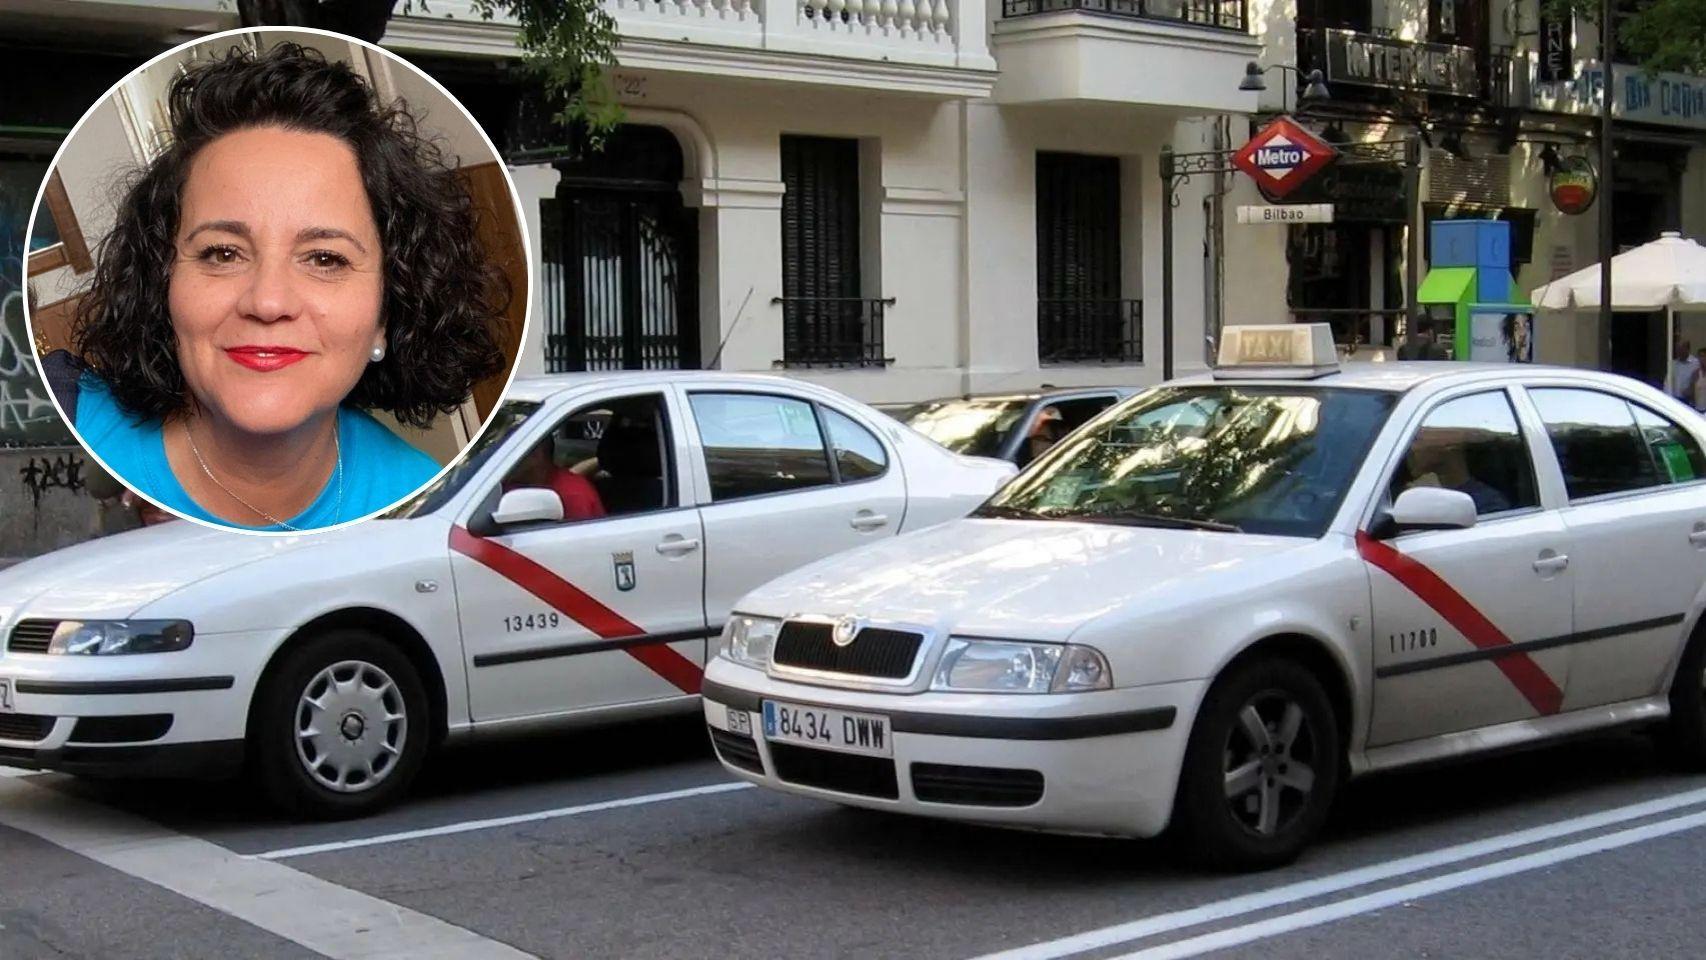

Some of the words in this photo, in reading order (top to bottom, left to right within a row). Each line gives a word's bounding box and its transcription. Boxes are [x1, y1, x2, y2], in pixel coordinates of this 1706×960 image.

[1257, 148, 1301, 166] Metro
[1263, 208, 1304, 221] Bilbao
[1242, 334, 1291, 358] TAXI
[503, 612, 559, 633] 13439
[727, 710, 748, 731] SP
[779, 706, 832, 743] 8434
[842, 715, 885, 749] DWW
